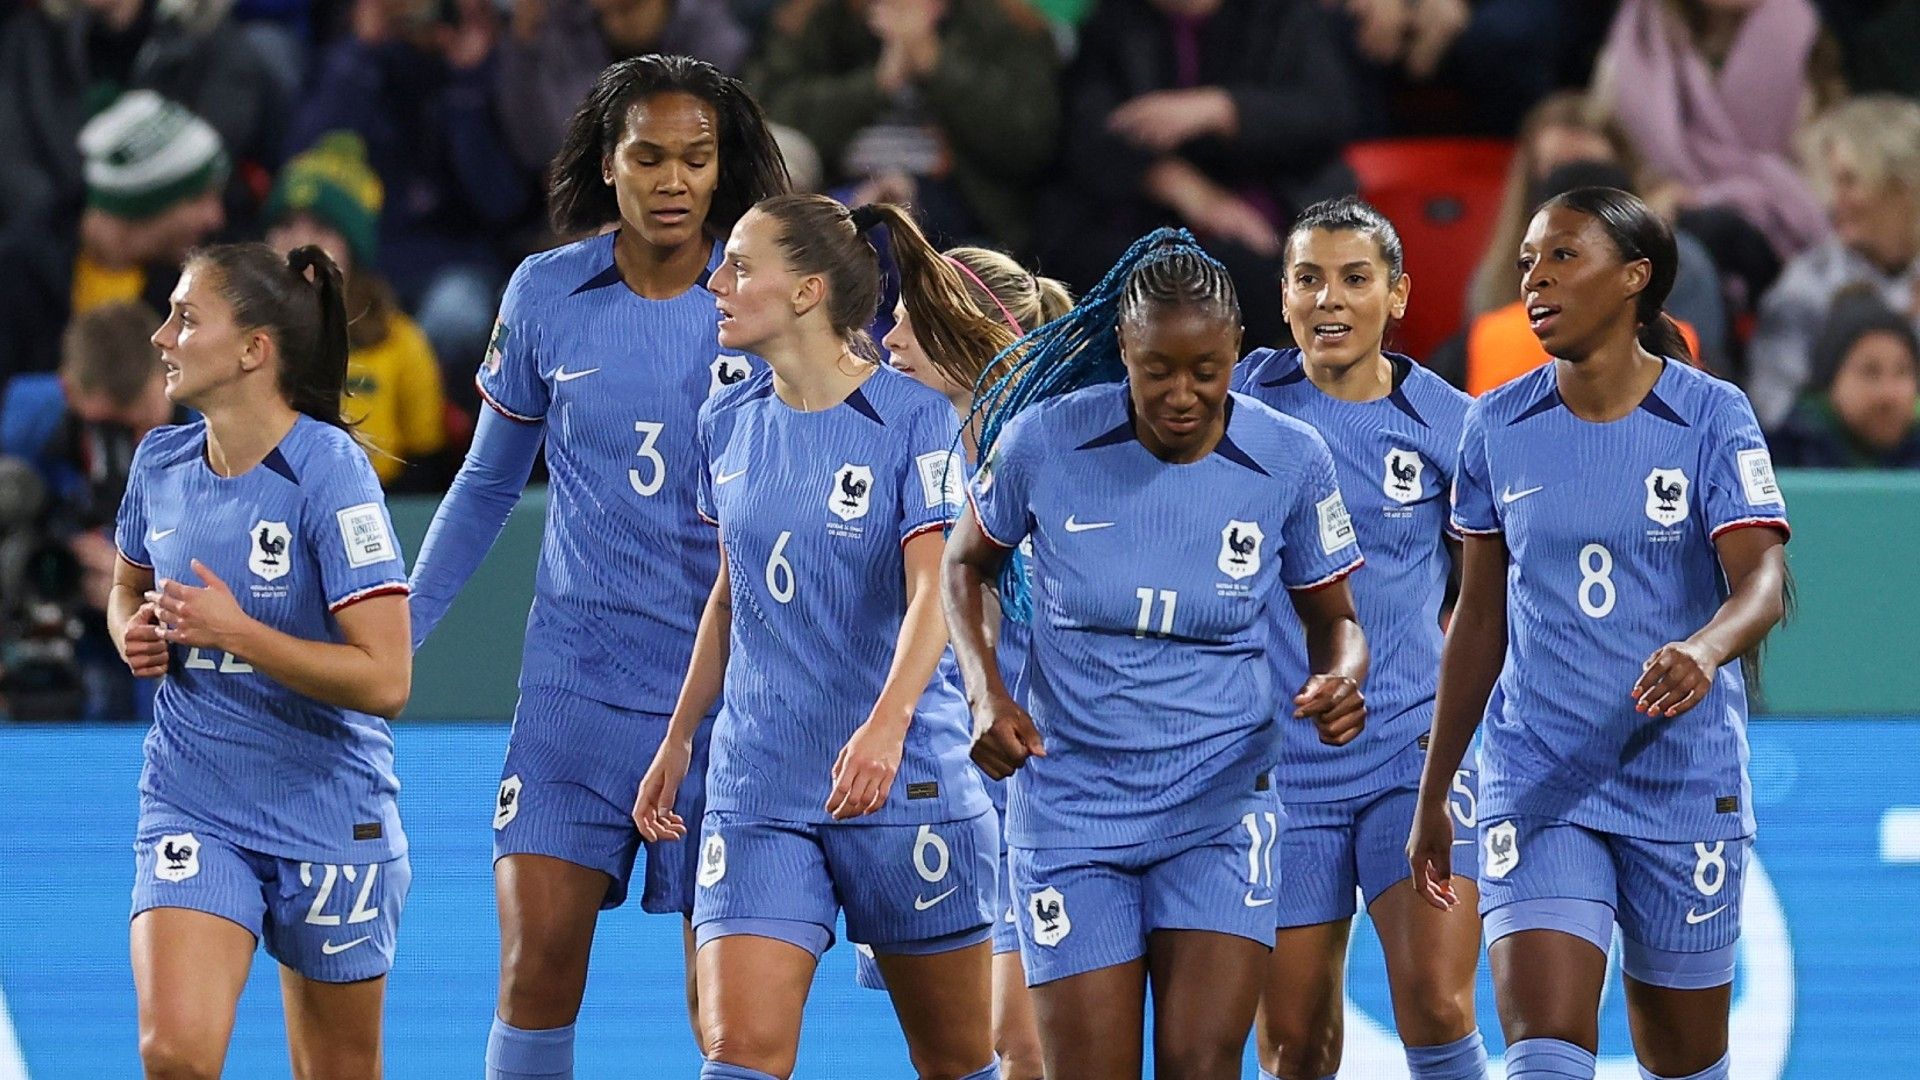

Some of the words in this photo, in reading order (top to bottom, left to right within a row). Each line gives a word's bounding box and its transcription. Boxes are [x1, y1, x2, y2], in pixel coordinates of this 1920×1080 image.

[628, 421, 665, 496] 3
[766, 530, 795, 604] 6
[1578, 543, 1616, 618] 8
[1135, 587, 1177, 639] 11
[913, 824, 949, 883] 6
[1241, 811, 1277, 888] 11
[1693, 840, 1725, 896] 8
[300, 862, 379, 926] 22
